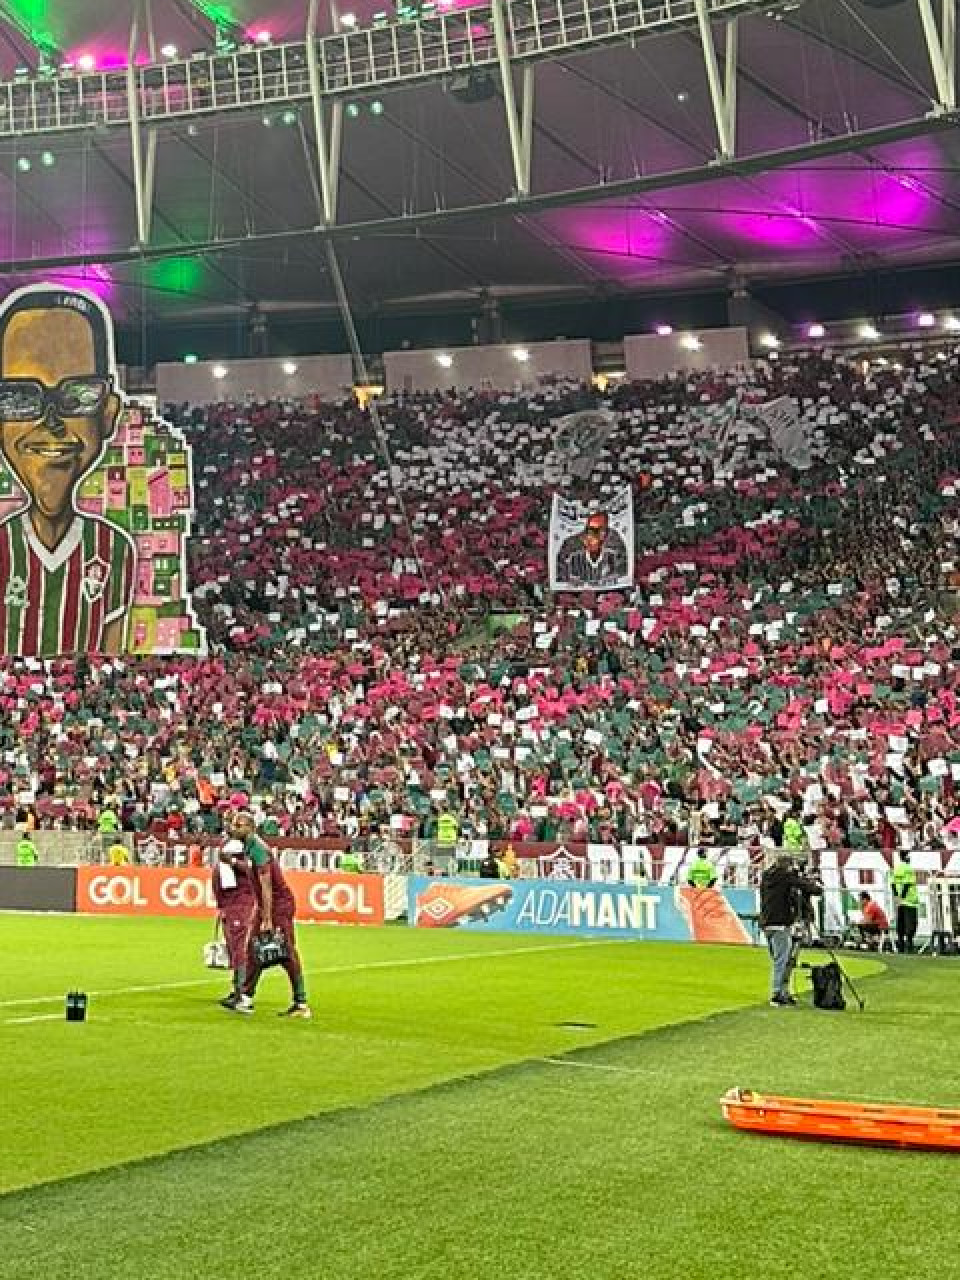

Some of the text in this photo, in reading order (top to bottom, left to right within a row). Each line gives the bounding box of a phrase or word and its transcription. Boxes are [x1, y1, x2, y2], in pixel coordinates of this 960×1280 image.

[90, 875, 148, 905] GOL
[160, 877, 217, 907] GOL
[310, 882, 374, 915] GOL
[516, 889, 661, 929] ADAMANT
